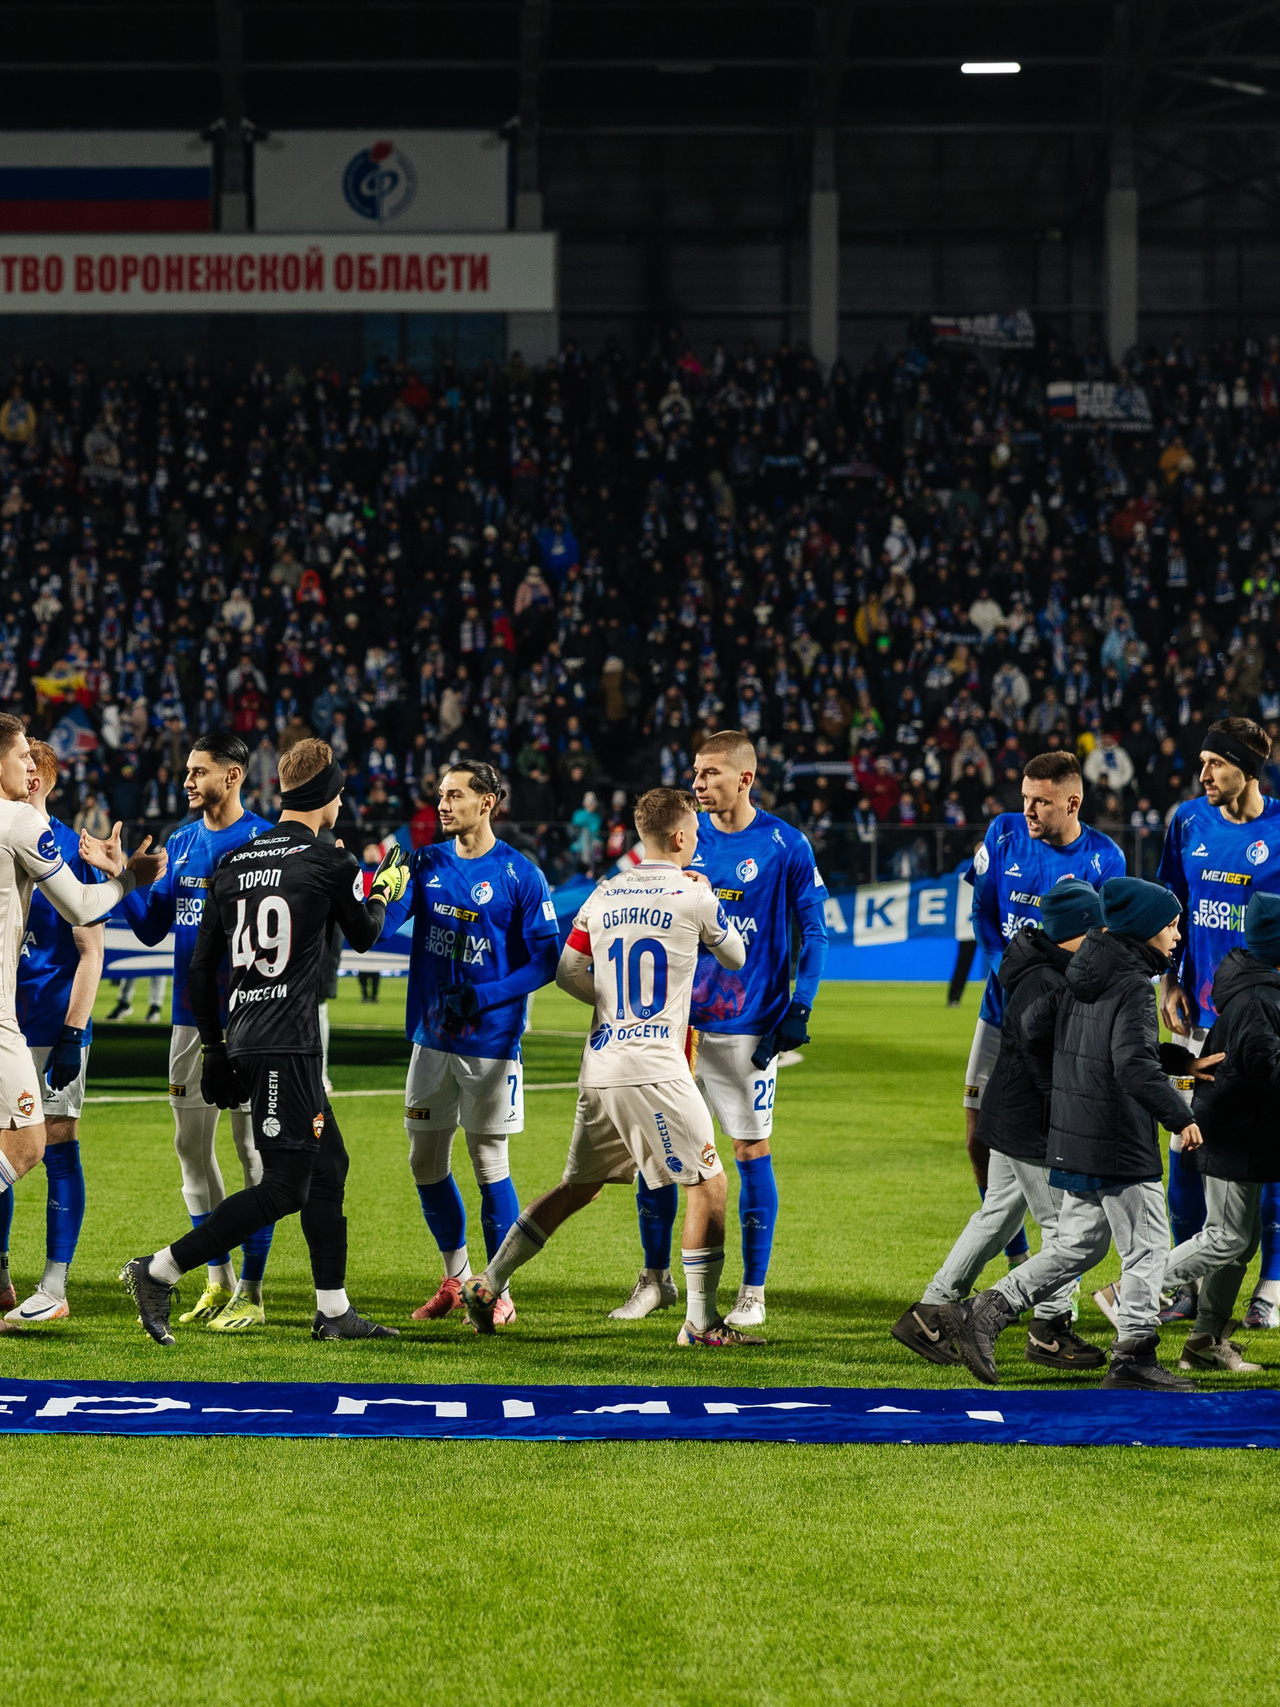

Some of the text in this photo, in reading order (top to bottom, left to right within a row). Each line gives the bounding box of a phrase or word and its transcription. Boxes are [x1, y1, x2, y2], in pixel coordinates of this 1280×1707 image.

[74, 245, 324, 296] ВОРОНЕЖСКОЙ
[333, 252, 490, 295] ОБЛАСТИ
[229, 847, 289, 864] АЭРОФЛОТ
[179, 876, 211, 888] МЕЛБЕ
[237, 868, 283, 891] ТОРОП
[1201, 869, 1251, 886] МЕЛБЕТ
[603, 887, 666, 897] АЭРОФЛОТ
[1010, 890, 1041, 907] МЕЛ
[603, 907, 673, 930] ОБЛЯКОВ
[824, 888, 948, 934] AKE
[1199, 898, 1248, 917] EKONI
[231, 895, 292, 978] 49
[608, 937, 668, 1020] 10
[616, 1024, 669, 1041] ОССЕТИ
[268, 1069, 279, 1115] РОССЕТИ
[507, 1075, 517, 1106] 7
[753, 1078, 774, 1111] 22
[654, 1112, 674, 1155] РОССЕТИ
